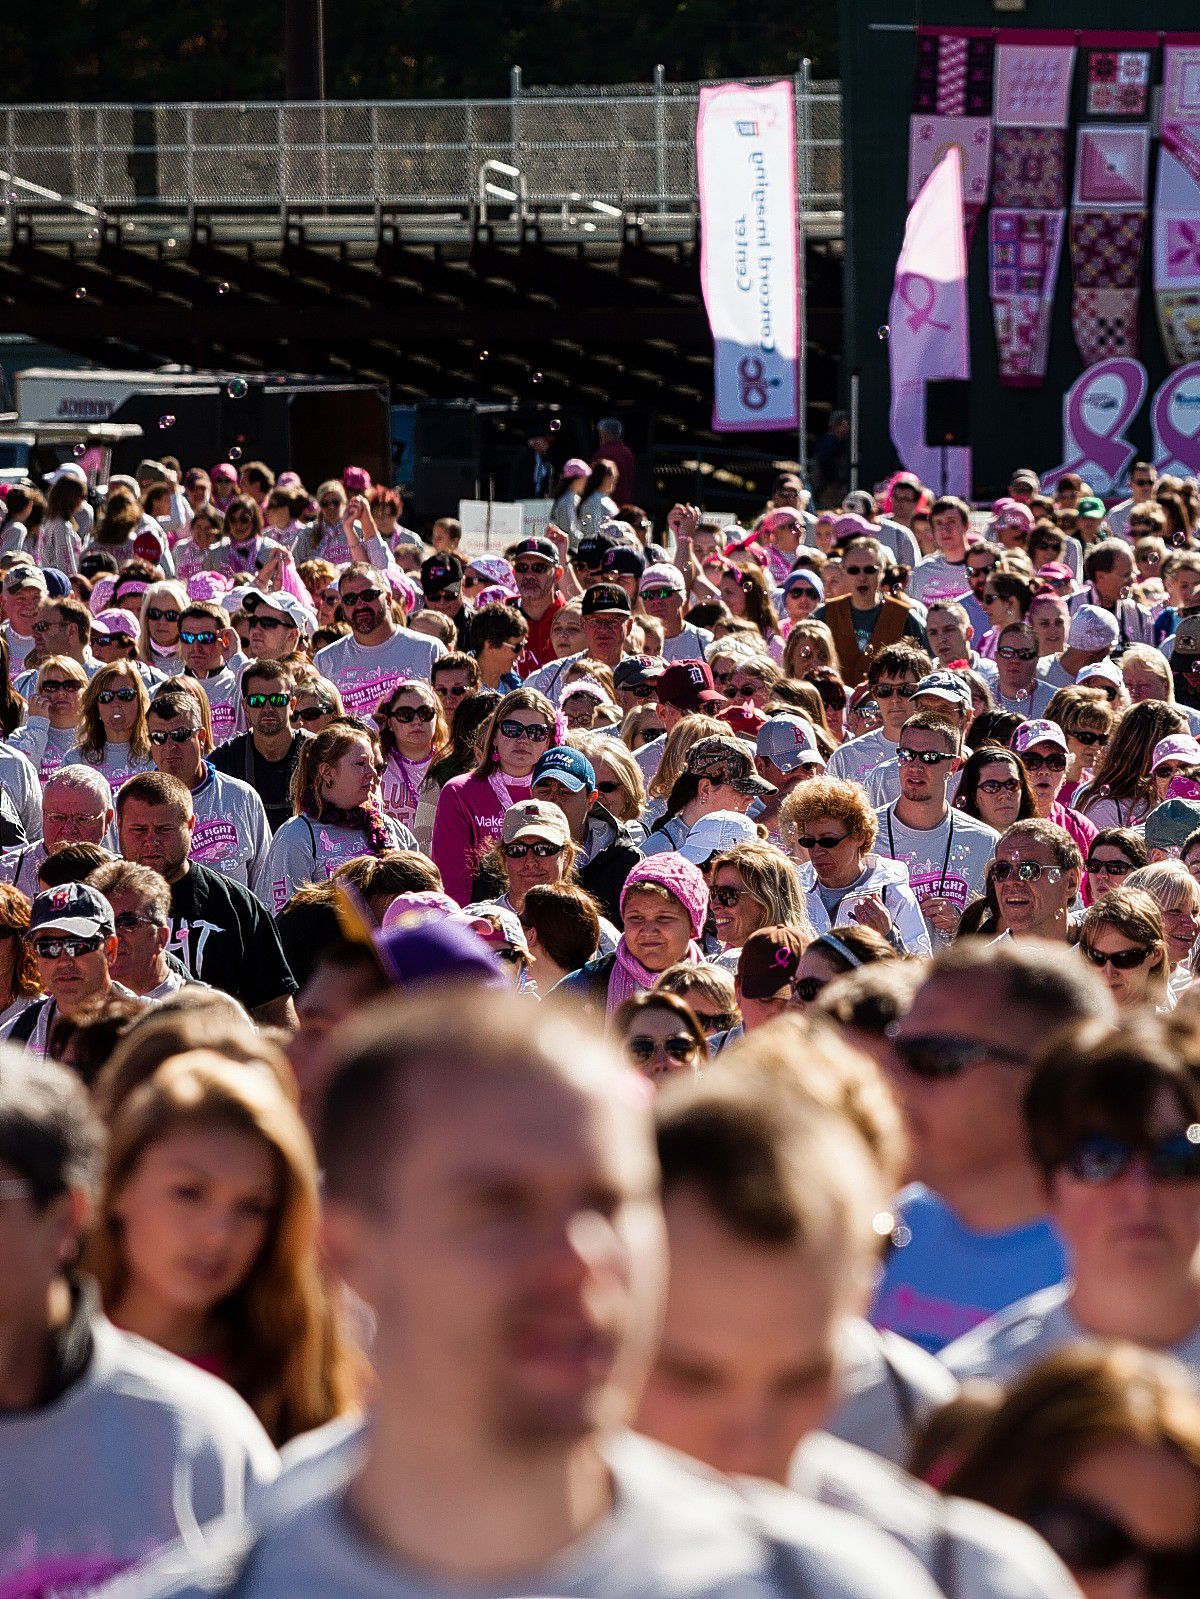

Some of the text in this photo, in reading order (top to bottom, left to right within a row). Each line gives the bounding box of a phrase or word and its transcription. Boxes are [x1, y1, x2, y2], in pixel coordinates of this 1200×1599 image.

[688, 667, 704, 684] D
[365, 681, 382, 696] THE
[791, 725, 805, 745] B
[474, 814, 504, 827] Make
[204, 824, 232, 837] FIGHT
[193, 834, 236, 850] breast cancer
[272, 876, 287, 913] TEA
[912, 880, 965, 896] THE FIGHT
[941, 890, 965, 901] cancer
[49, 890, 69, 911] B
